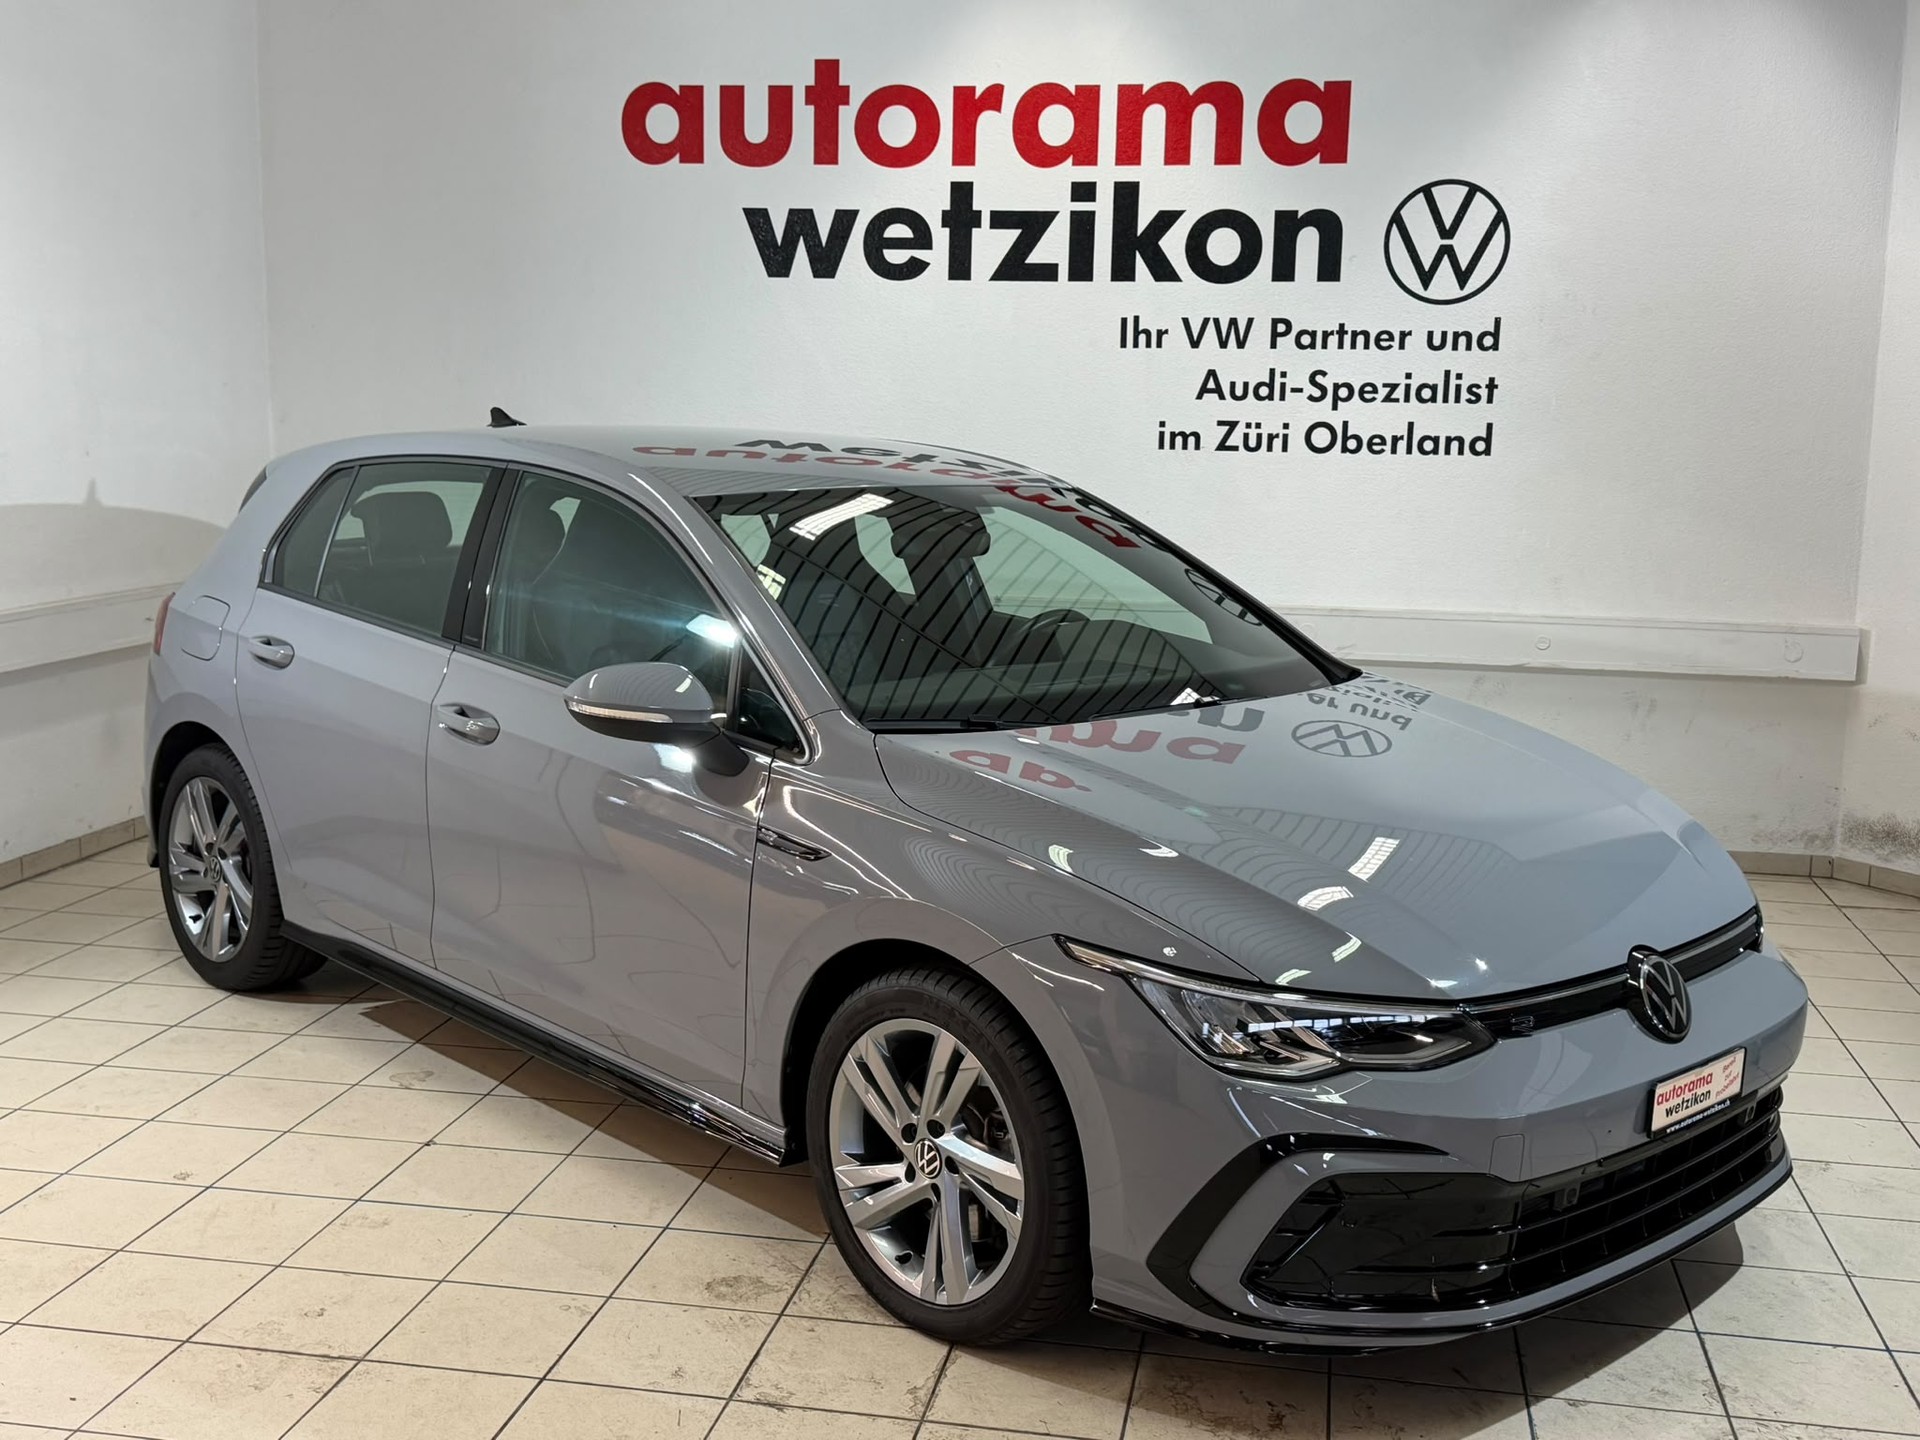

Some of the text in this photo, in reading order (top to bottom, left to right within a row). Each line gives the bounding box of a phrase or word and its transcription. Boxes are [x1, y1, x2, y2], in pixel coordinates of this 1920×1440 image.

[621, 58, 1352, 168] autorama
[742, 181, 1344, 285] wetzikon
[1383, 178, 1511, 306] VW
[1119, 315, 1502, 352] Ihr VW Partner und
[1195, 367, 1499, 411] Audi-Spezialist
[1158, 420, 1494, 457] im Züri Oberland
[1638, 956, 1690, 1037] VW
[1656, 1071, 1714, 1106] autorama
[1664, 1088, 1712, 1118] wetzikon
